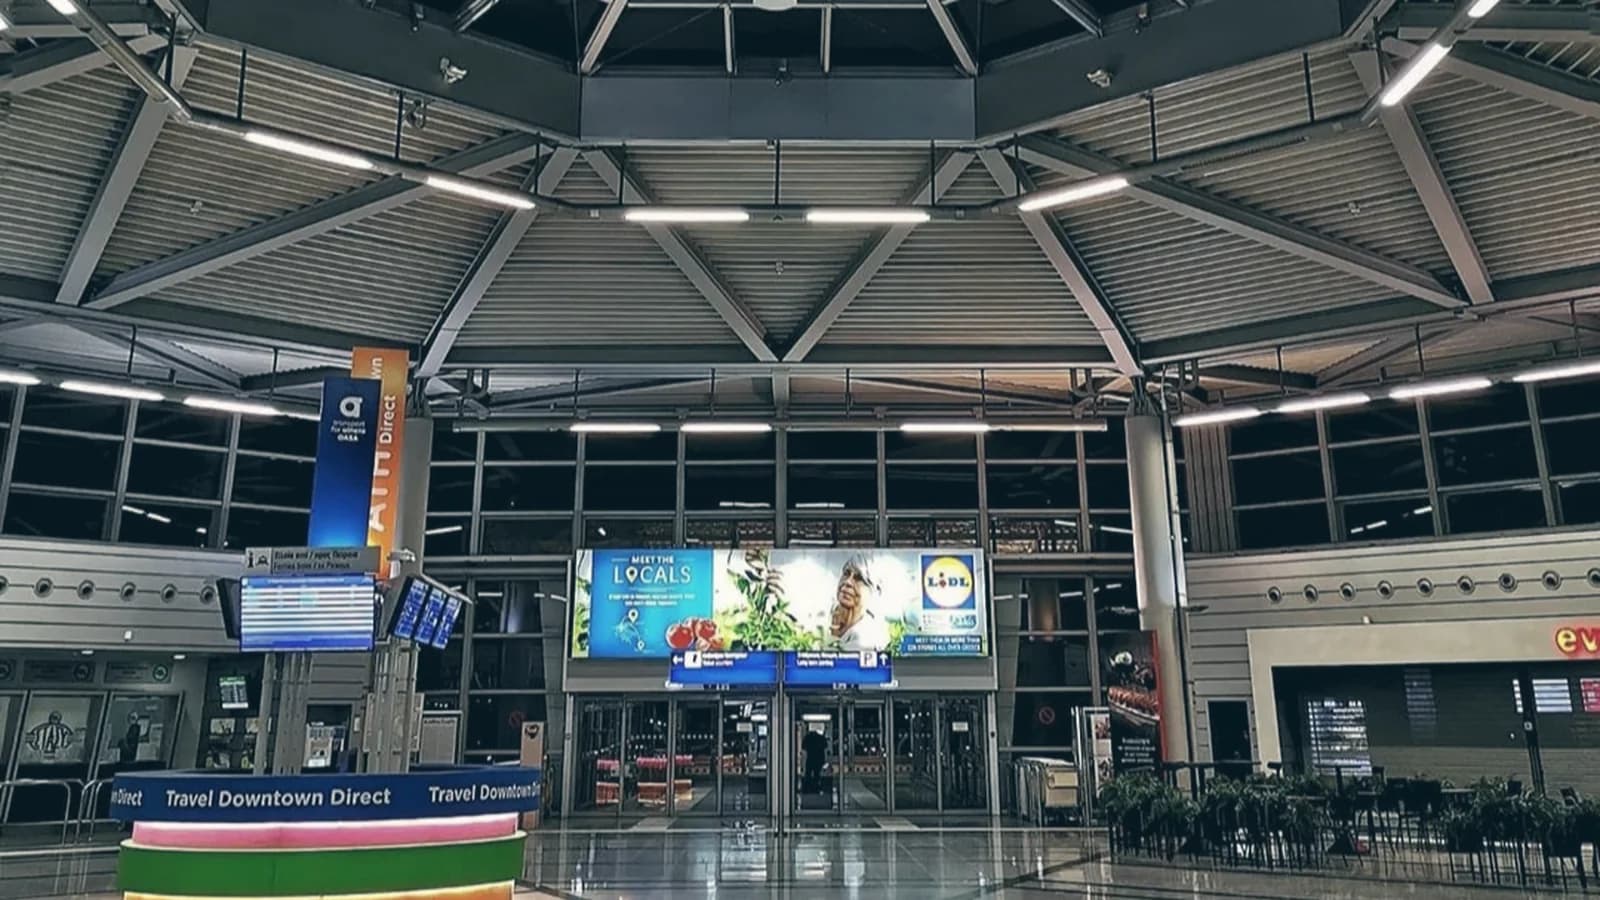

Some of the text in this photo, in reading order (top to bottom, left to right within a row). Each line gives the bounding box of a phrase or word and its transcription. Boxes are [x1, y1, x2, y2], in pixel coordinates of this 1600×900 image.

[379, 394, 396, 444] Direct
[631, 555, 674, 564] MEET THE
[613, 565, 692, 584] LOCALS
[117, 788, 143, 806] Direct
[166, 787, 391, 808] Travel Downtown Direct
[428, 784, 477, 803] Travel
[480, 782, 531, 801] Downtown
